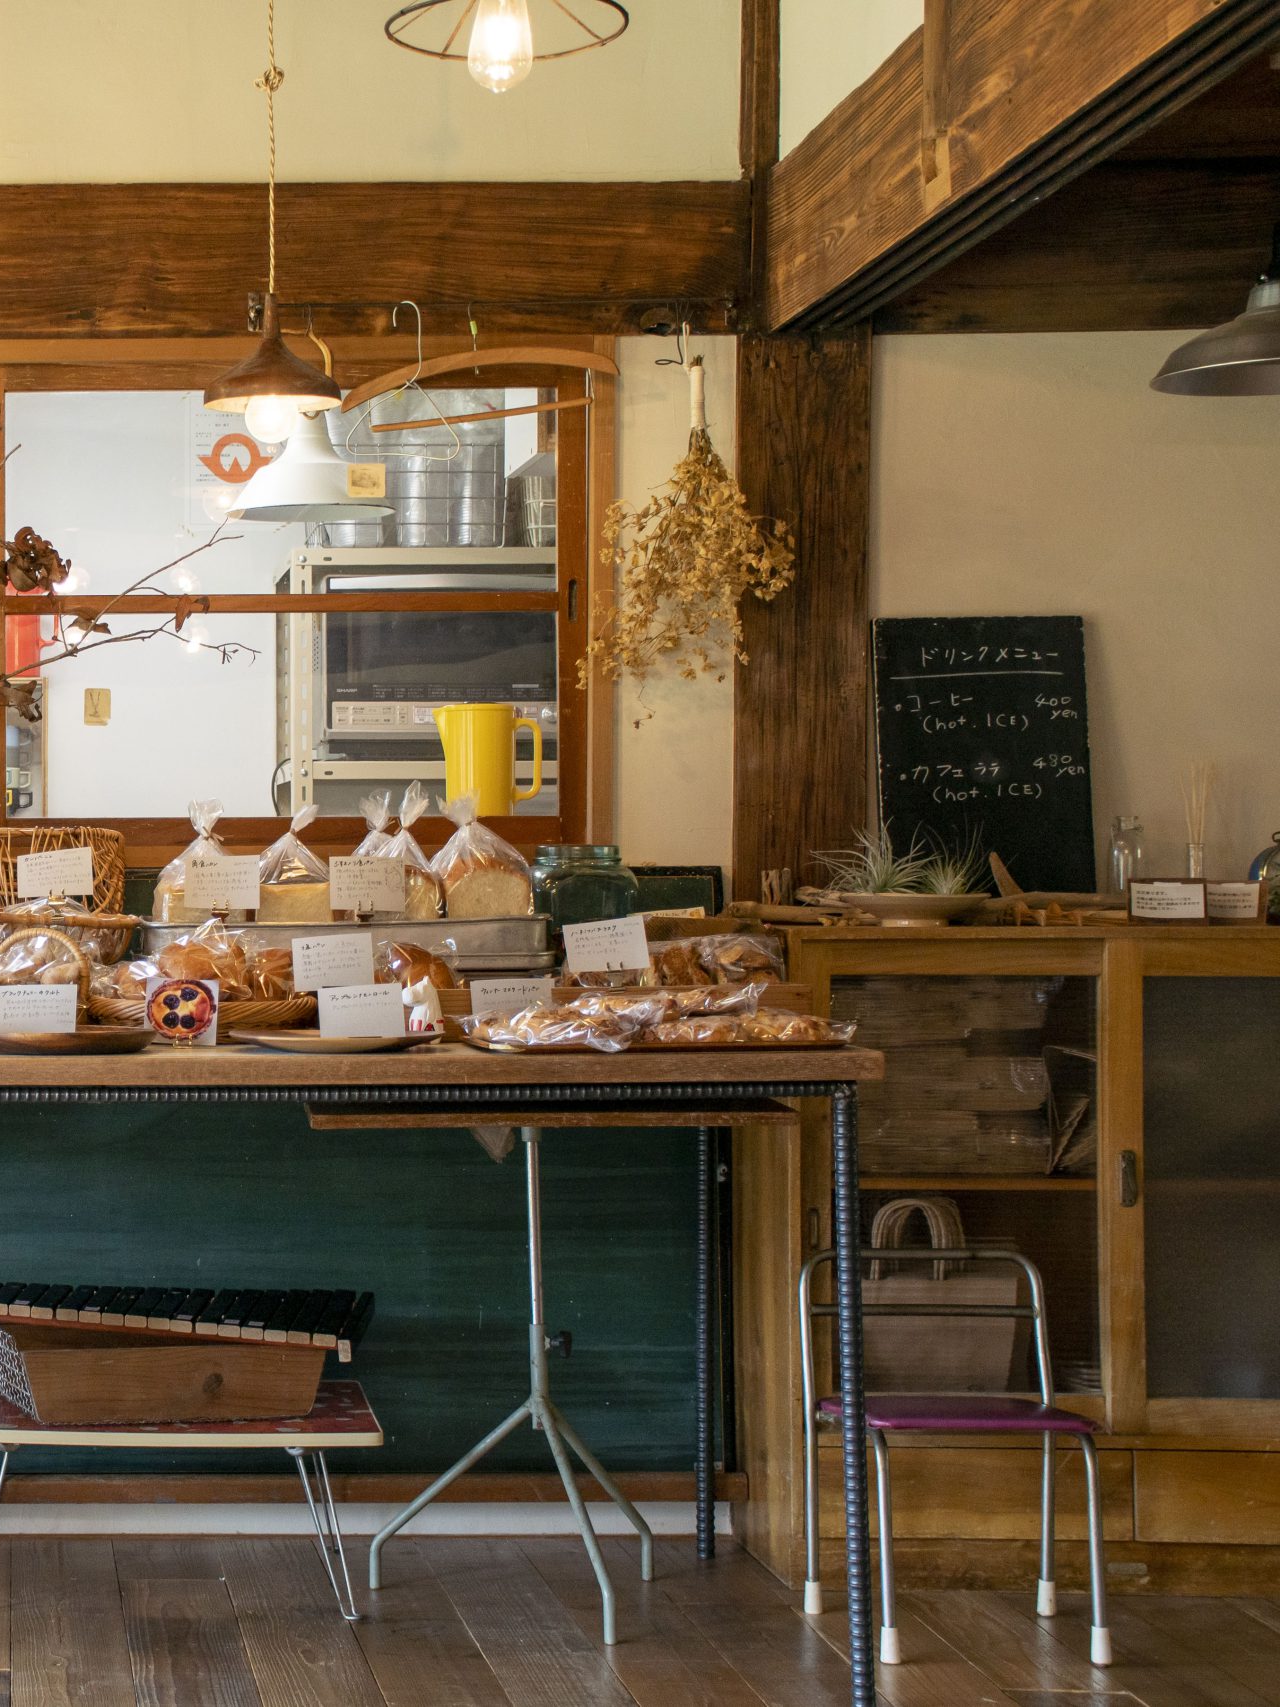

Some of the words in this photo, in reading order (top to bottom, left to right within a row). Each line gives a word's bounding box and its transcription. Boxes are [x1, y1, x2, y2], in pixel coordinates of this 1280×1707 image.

[921, 646, 1058, 667] ドリンクメニュー
[1034, 693, 1072, 708] 400
[1050, 709, 1078, 720] yen
[1033, 754, 1072, 769] 480
[1055, 766, 1085, 778] yen
